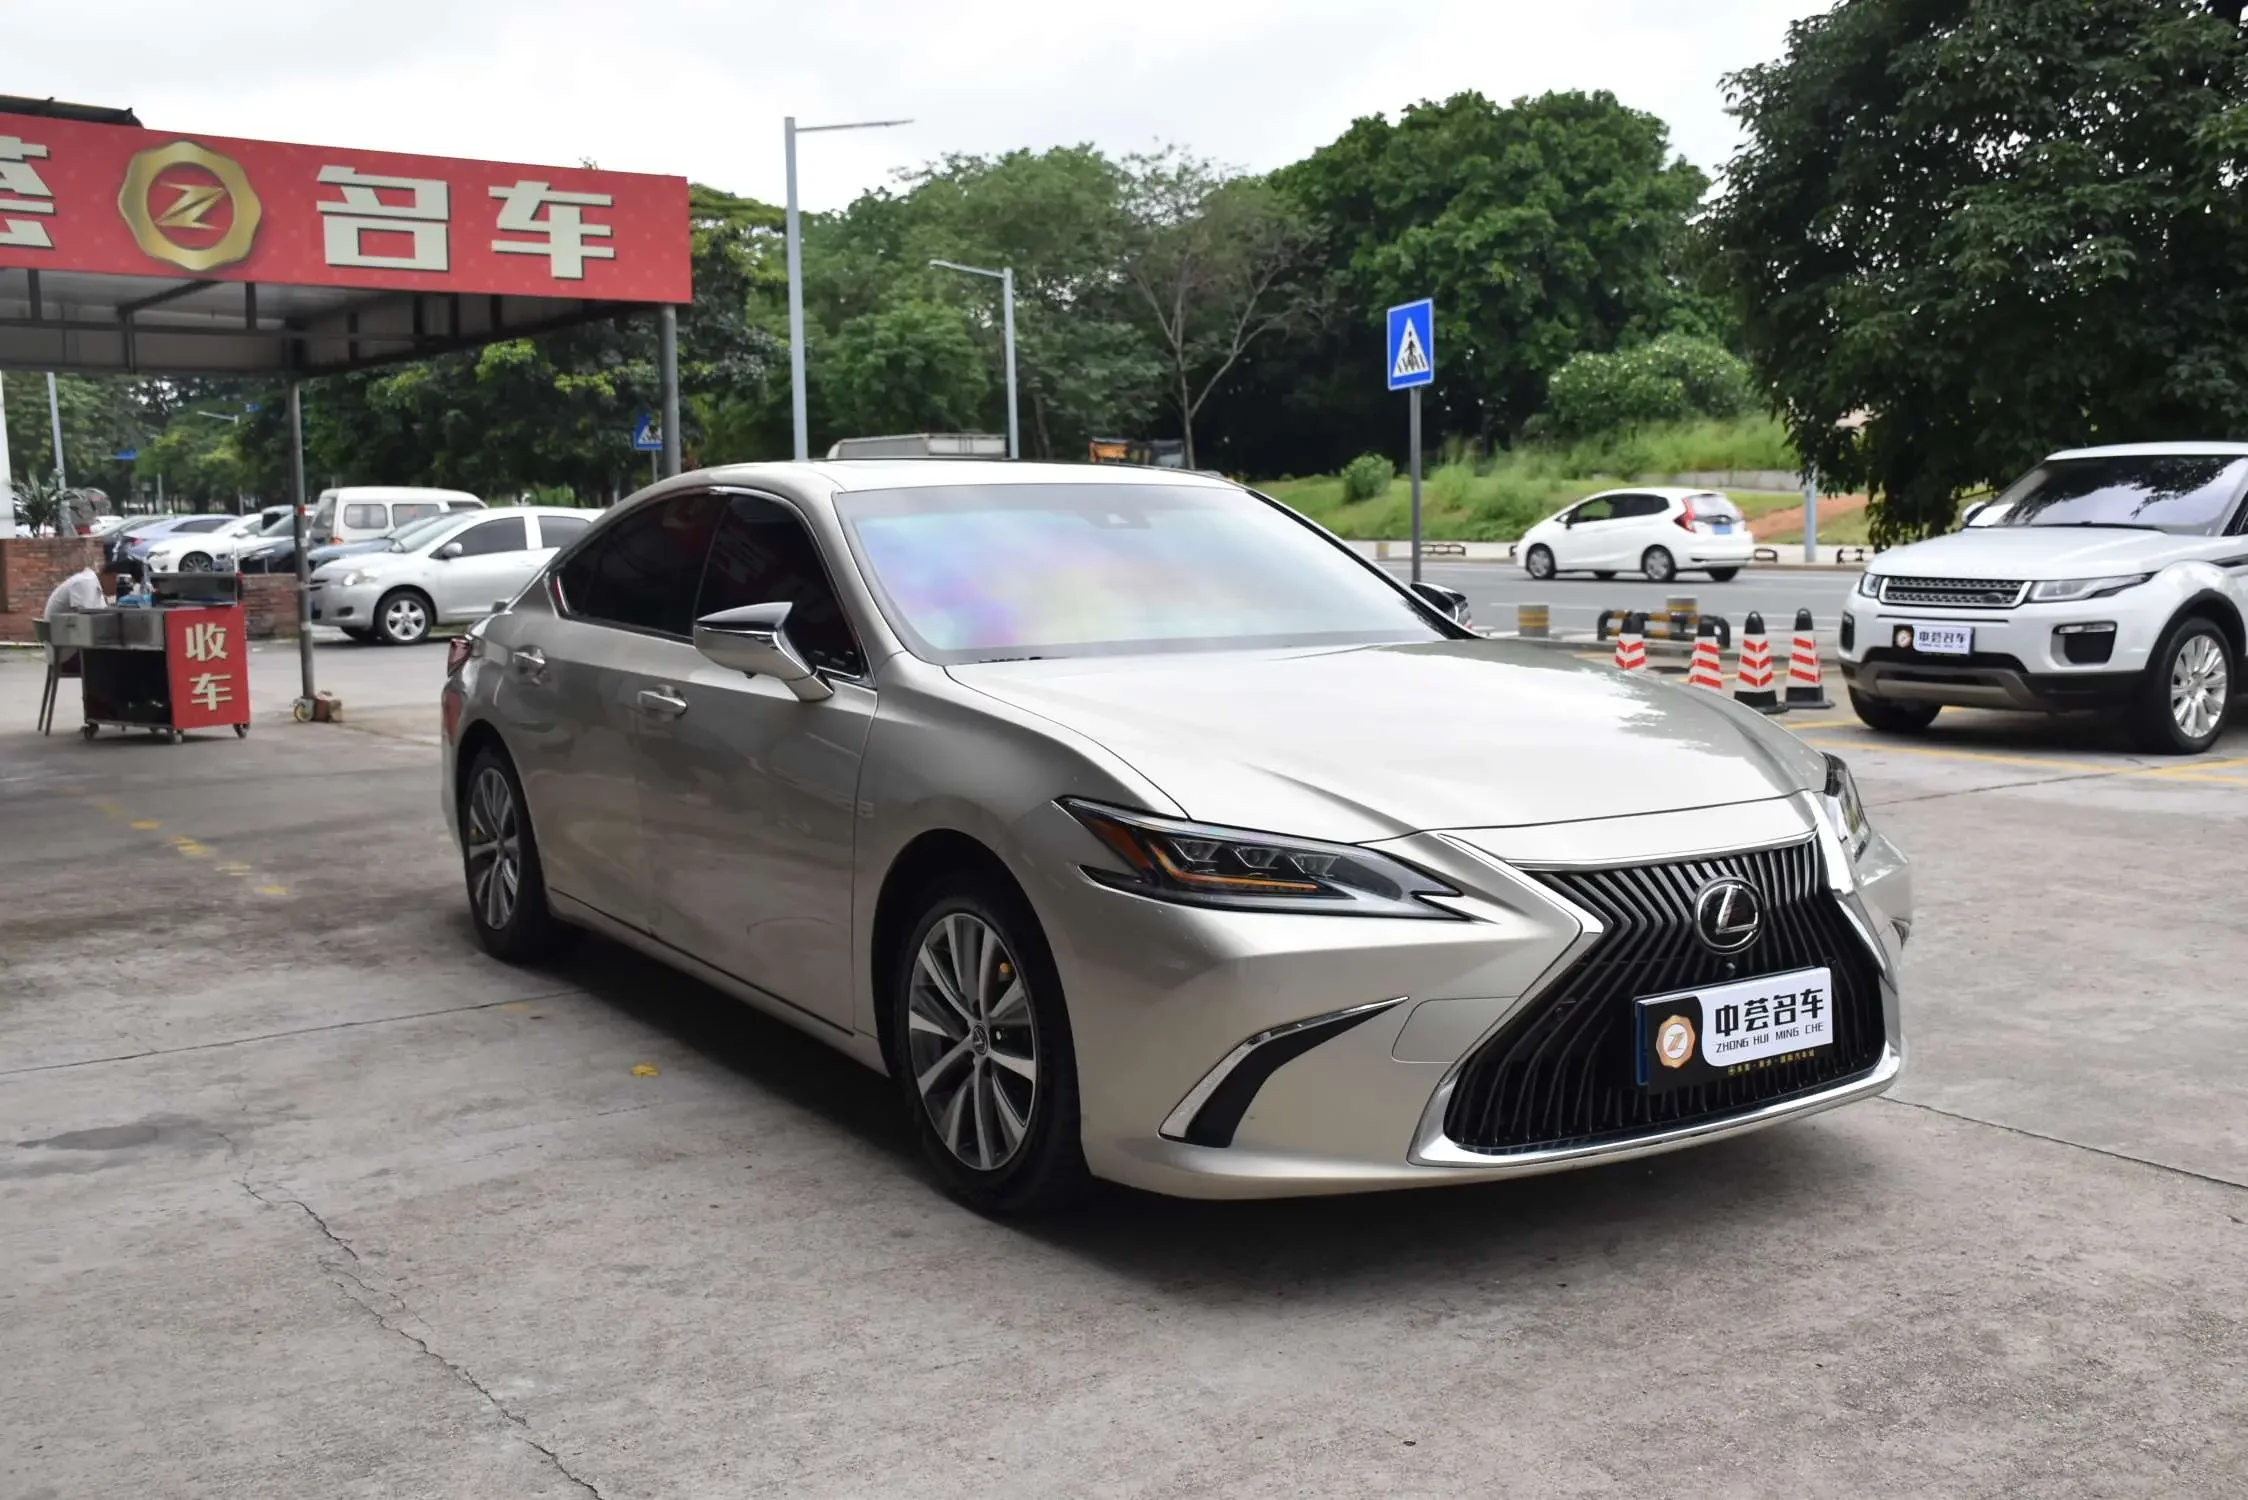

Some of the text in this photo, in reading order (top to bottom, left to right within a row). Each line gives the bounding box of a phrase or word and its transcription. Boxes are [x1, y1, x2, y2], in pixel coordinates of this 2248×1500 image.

[1715, 988, 1824, 1037] 中荟名车
[1716, 1021, 1824, 1053] ZHONG HUI MING CHE
